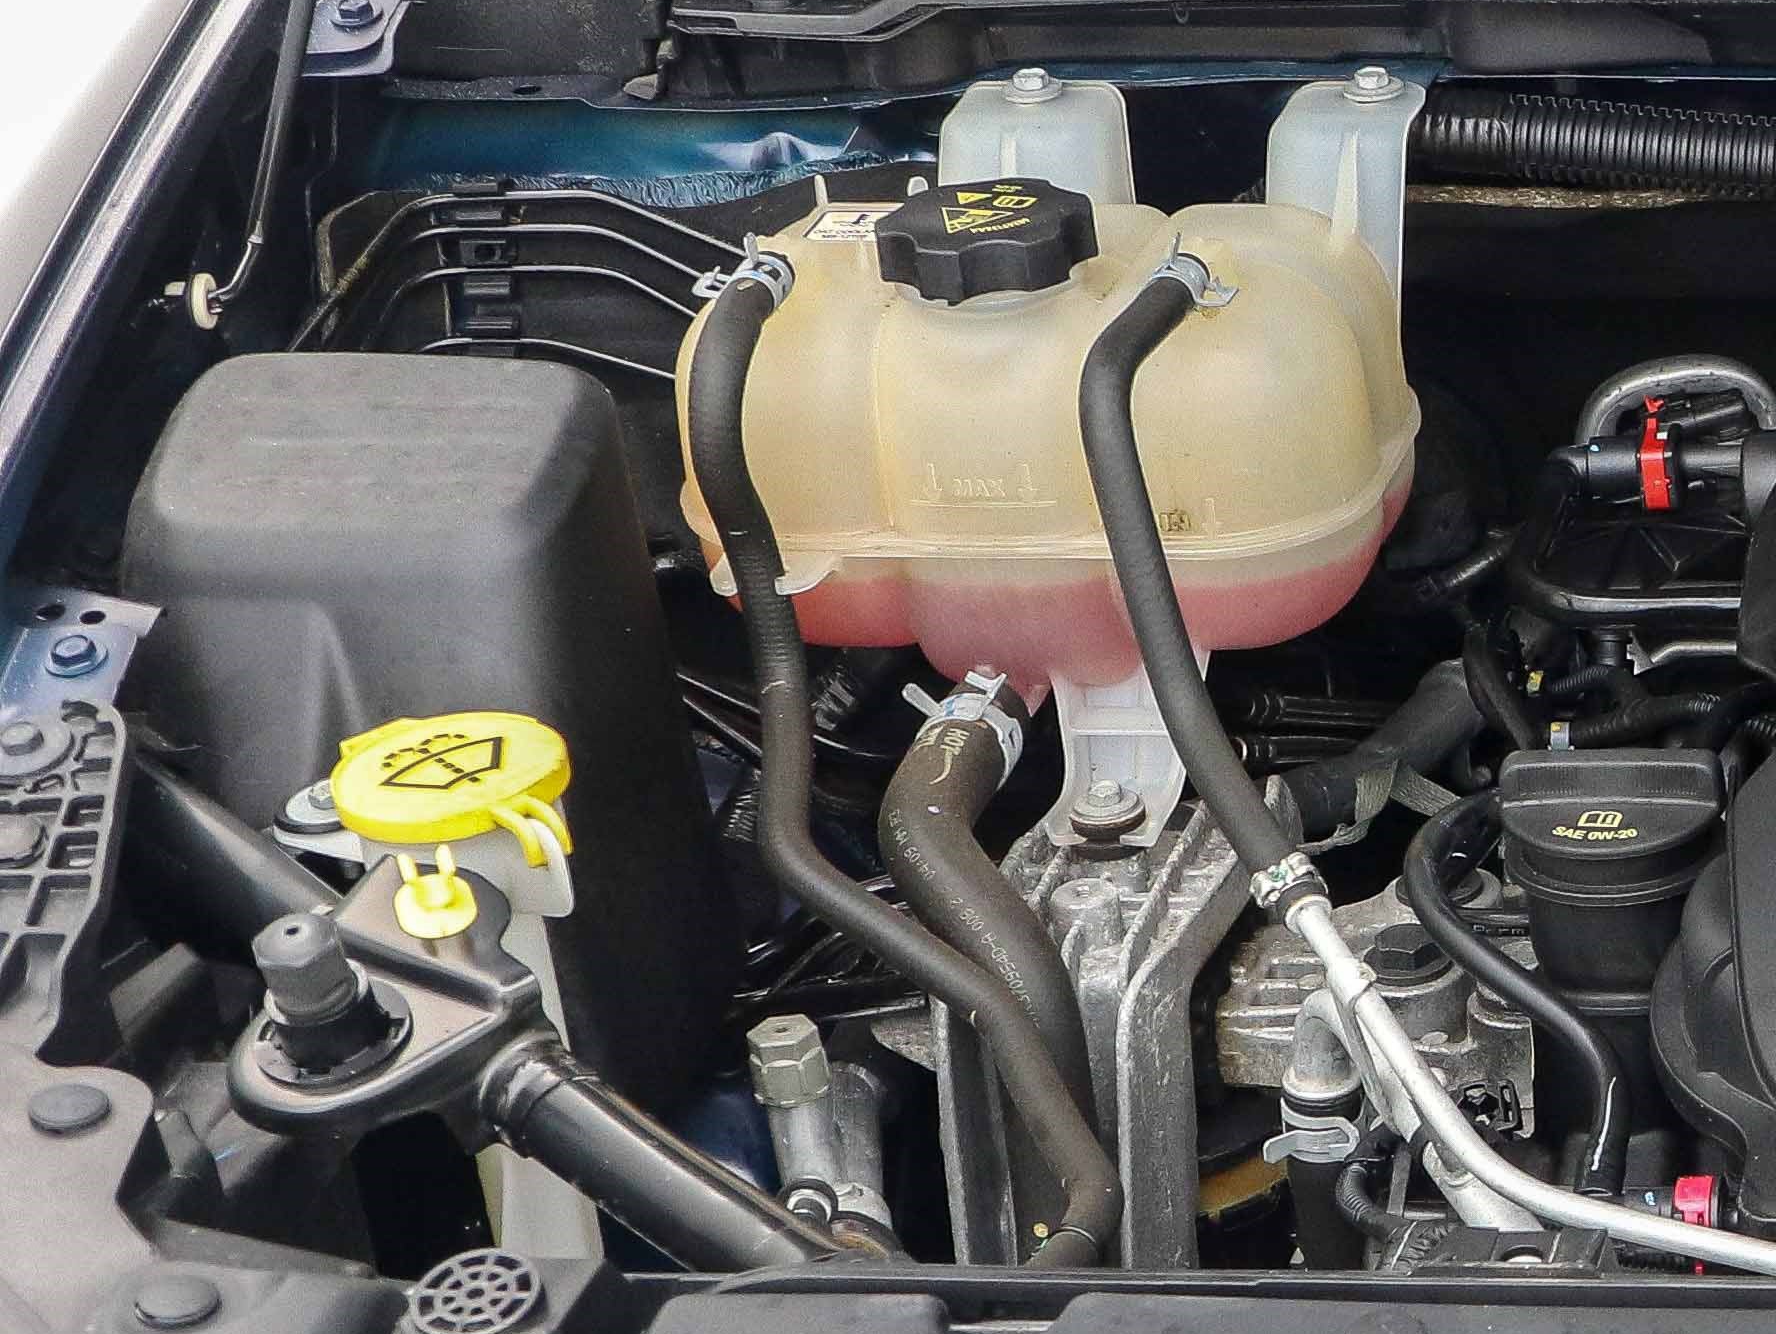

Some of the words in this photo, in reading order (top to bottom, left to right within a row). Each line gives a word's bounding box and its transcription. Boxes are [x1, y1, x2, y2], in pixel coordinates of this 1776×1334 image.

[940, 728, 970, 755] HOT
[1552, 827, 1587, 840] SAE
[1587, 829, 1638, 840] 0W-20
